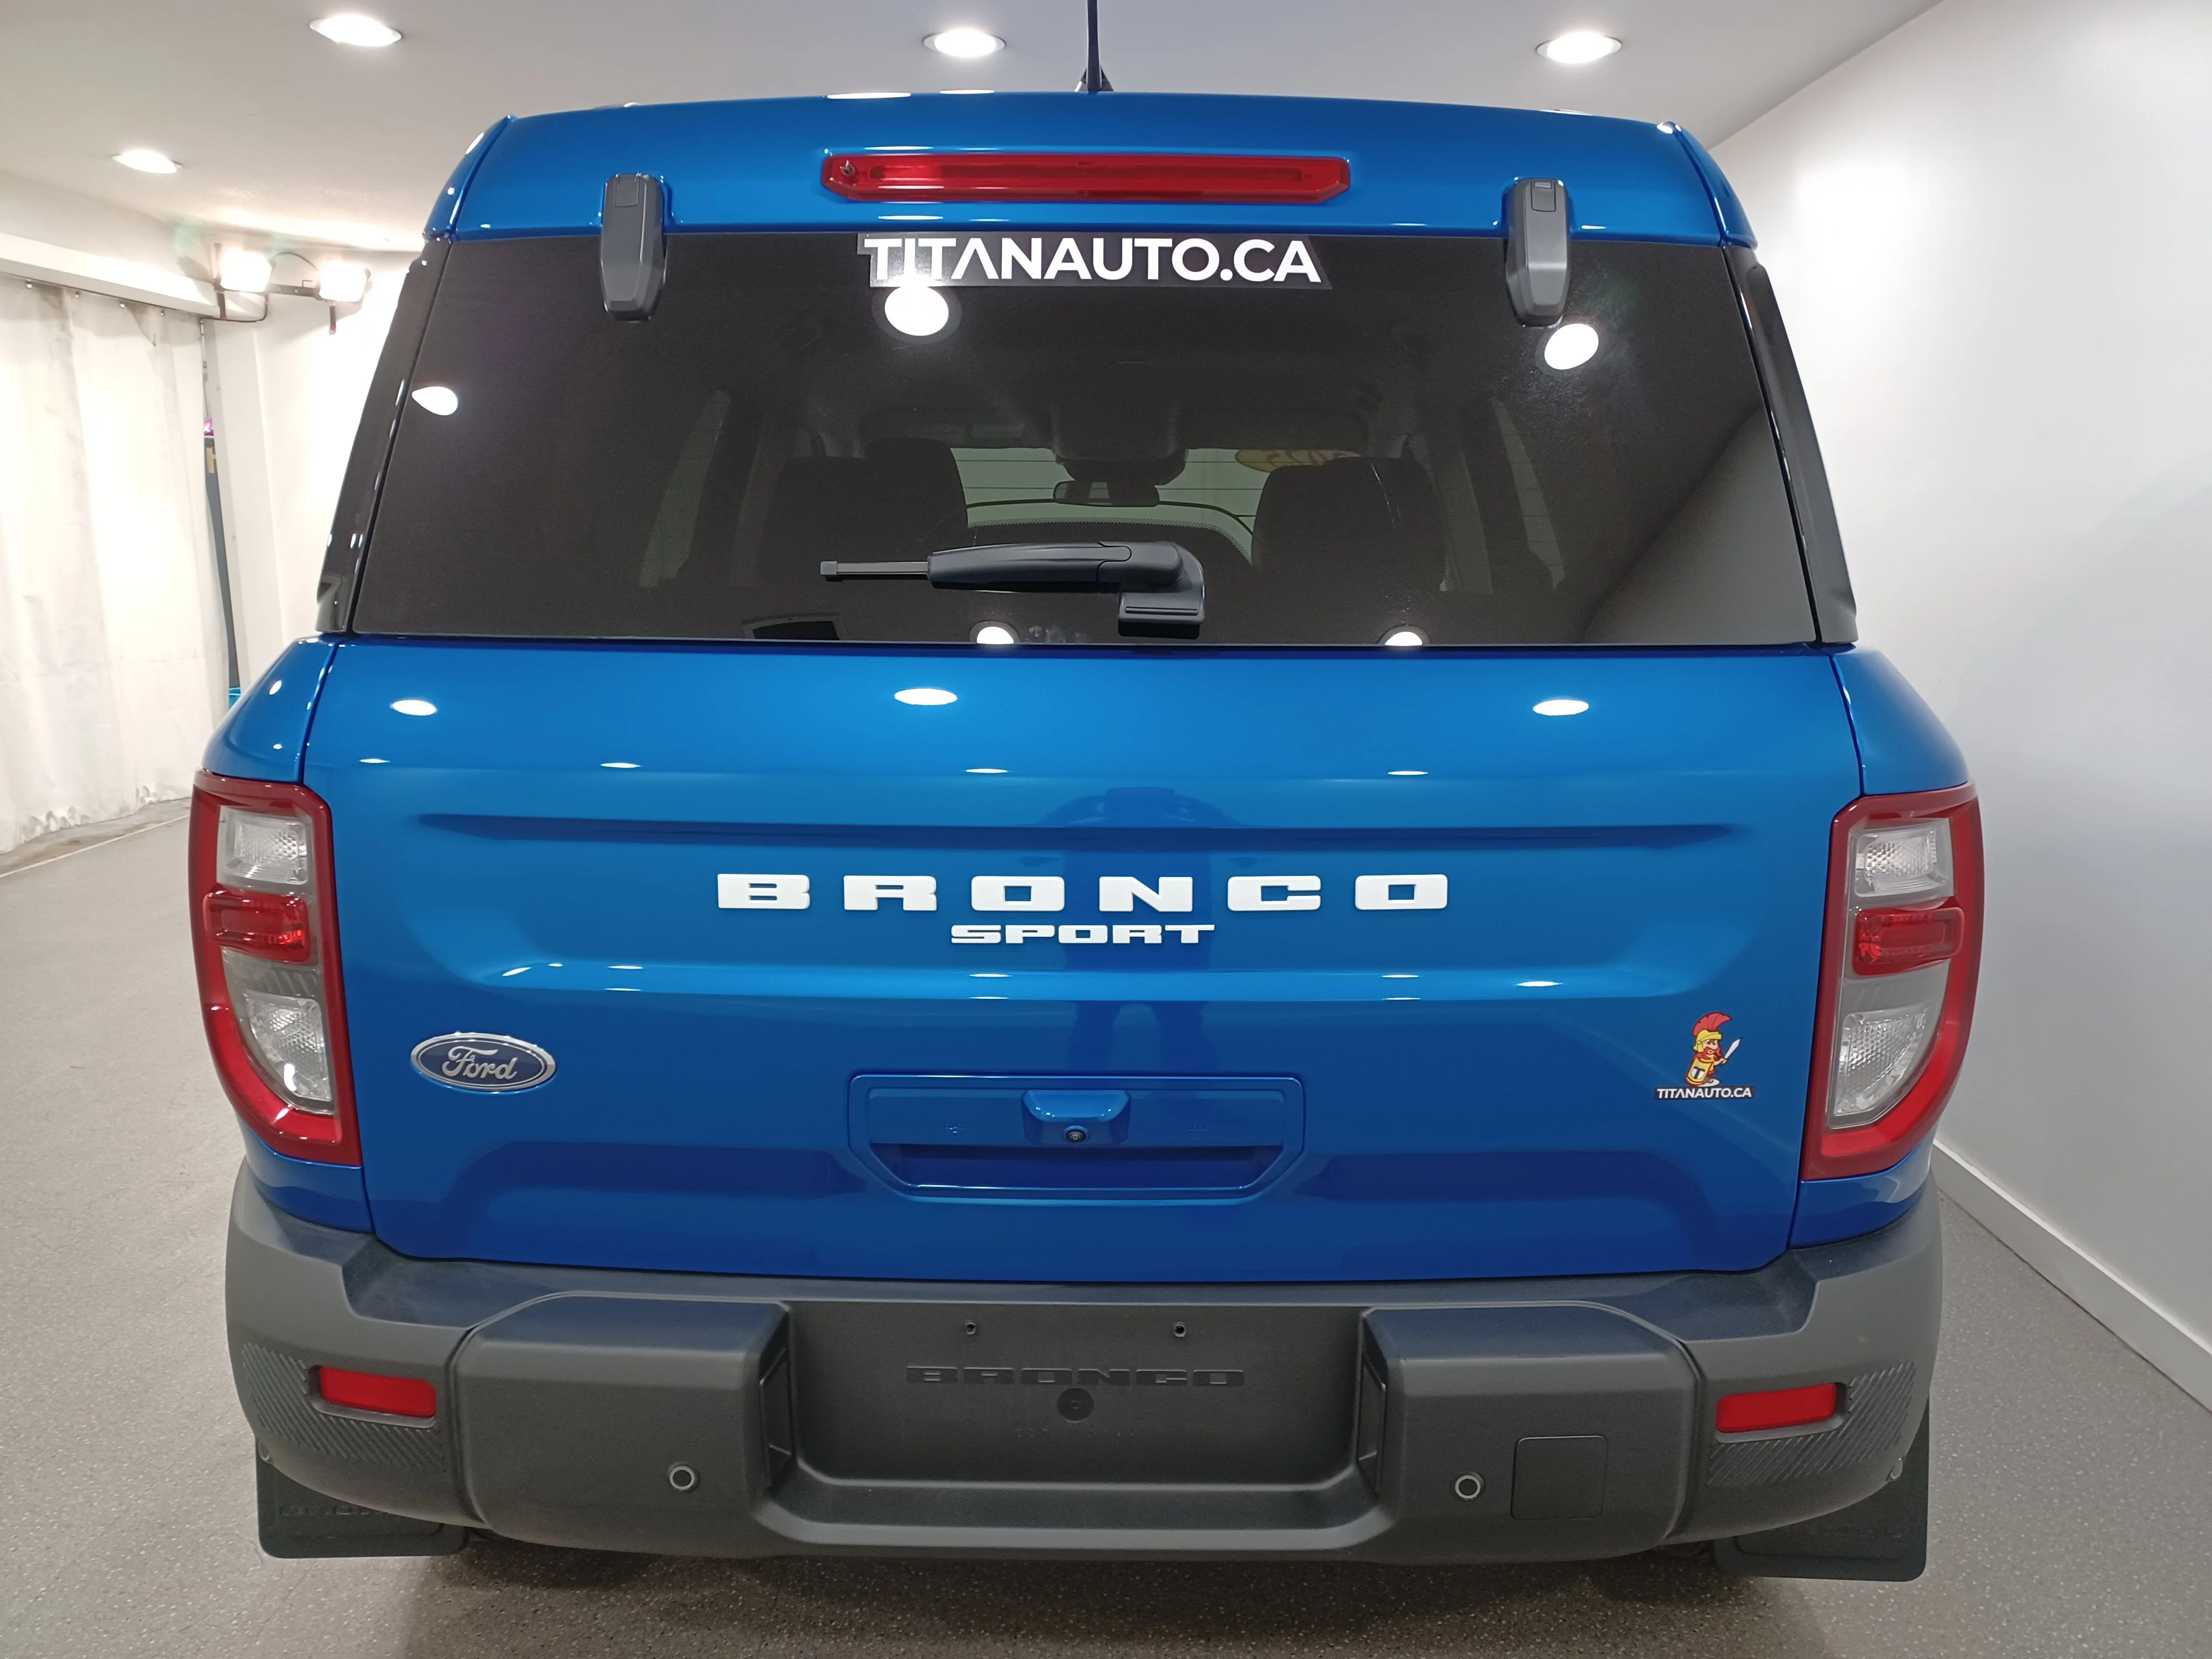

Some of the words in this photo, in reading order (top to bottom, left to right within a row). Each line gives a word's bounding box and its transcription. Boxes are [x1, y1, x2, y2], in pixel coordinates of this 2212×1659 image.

[864, 237, 1322, 283] TITANAUTO.CA
[717, 873, 1448, 913] BRONCO
[950, 924, 1215, 945] SPORT
[442, 1046, 518, 1079] Ford
[1693, 1066, 1705, 1079] T
[1657, 1087, 1752, 1099] TITANAUTO.CA
[905, 1365, 1245, 1385] BRONCO
